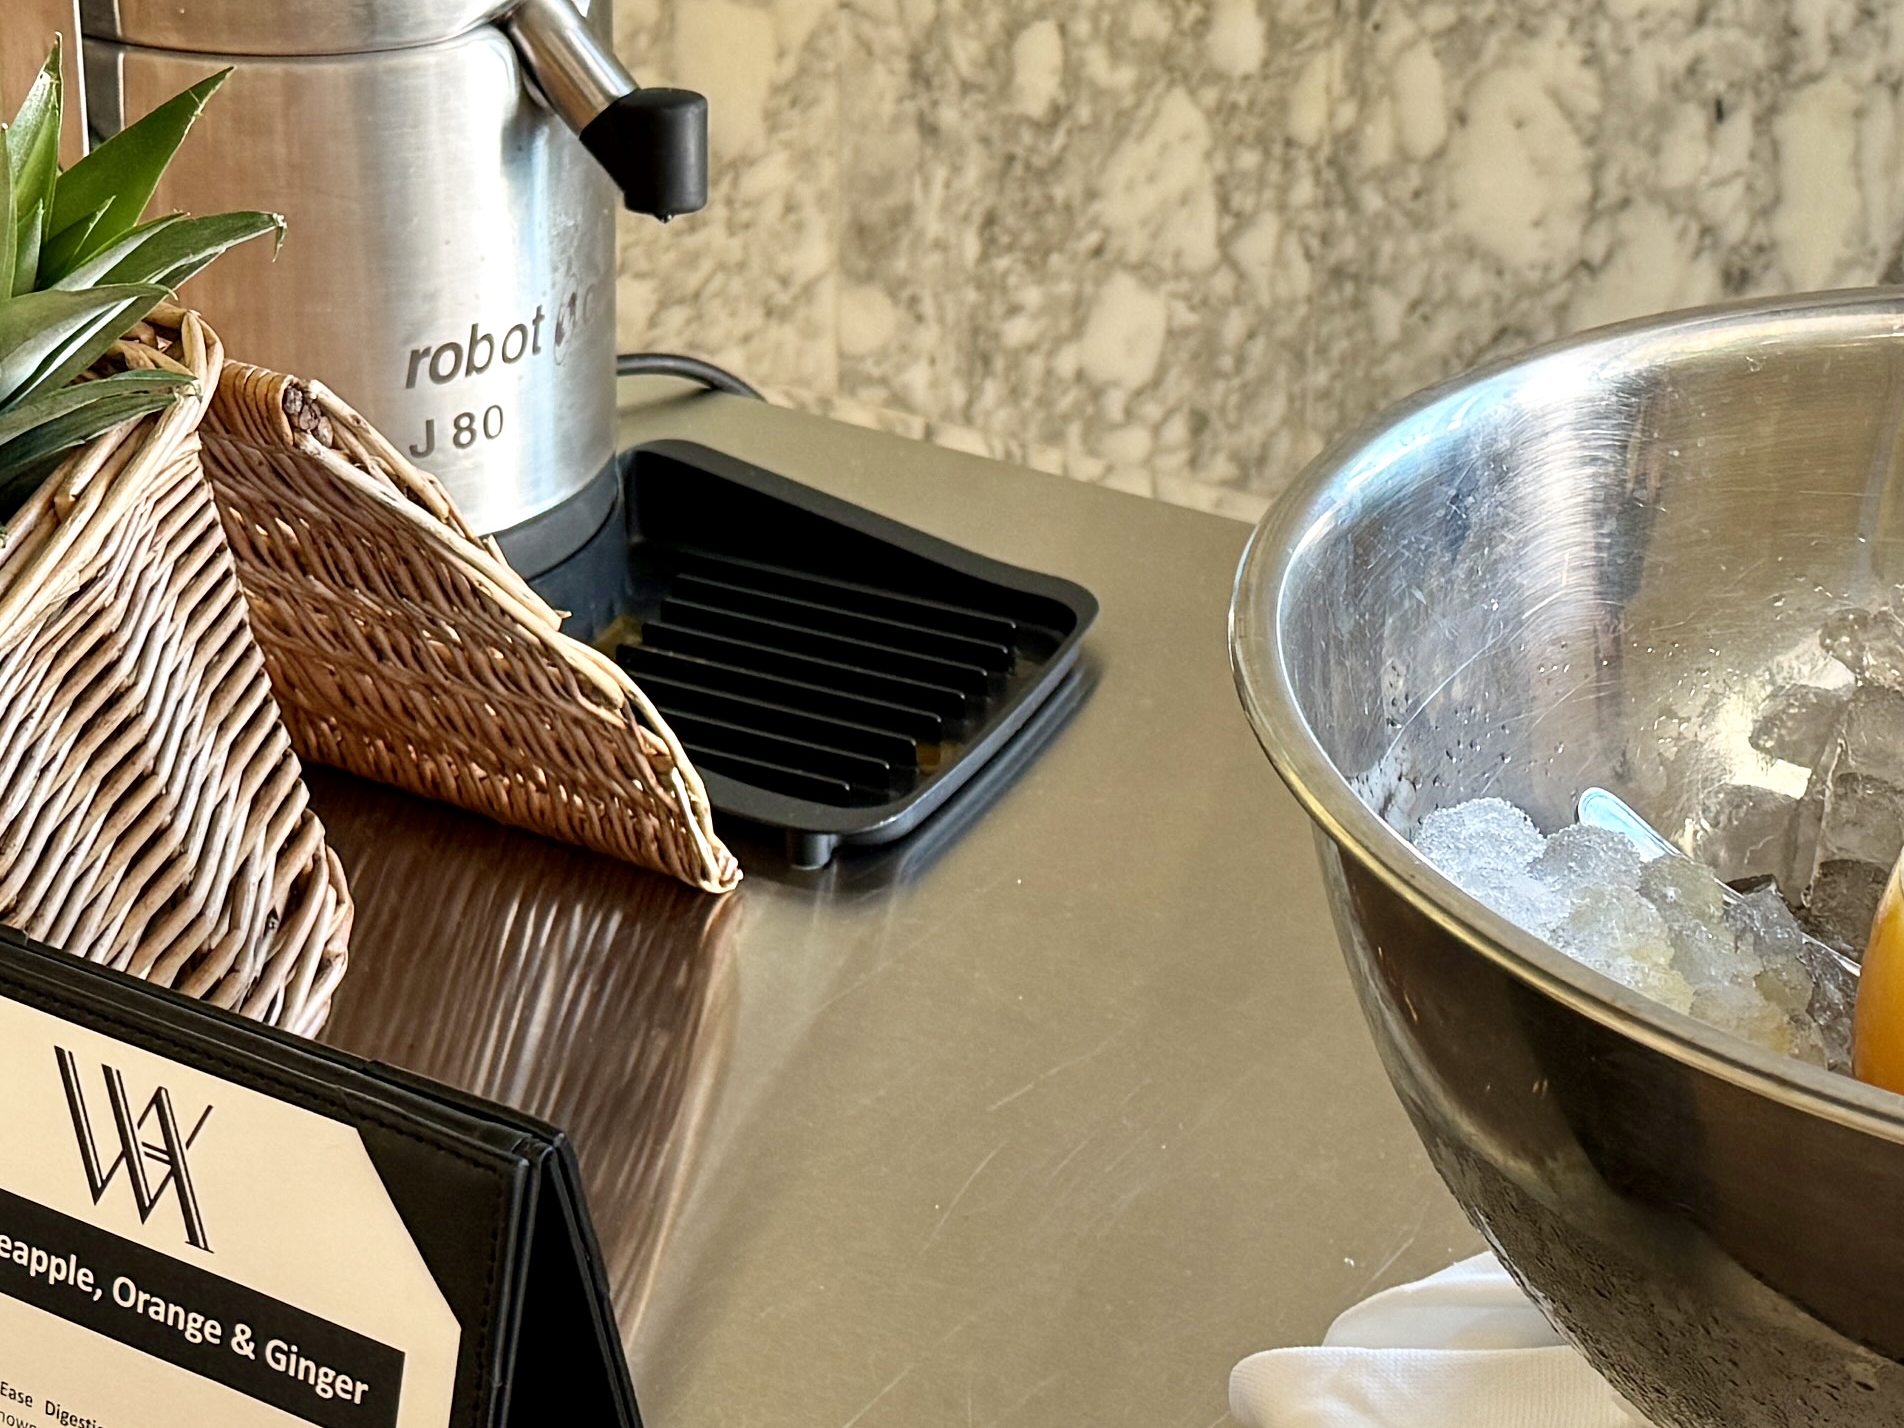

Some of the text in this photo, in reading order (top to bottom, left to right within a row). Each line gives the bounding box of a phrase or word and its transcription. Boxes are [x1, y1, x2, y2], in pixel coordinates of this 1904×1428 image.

[405, 304, 545, 389] robot
[408, 404, 504, 460] J 80
[111, 1275, 222, 1345] Orange
[229, 1322, 256, 1360] &
[264, 1338, 369, 1405] Ginger
